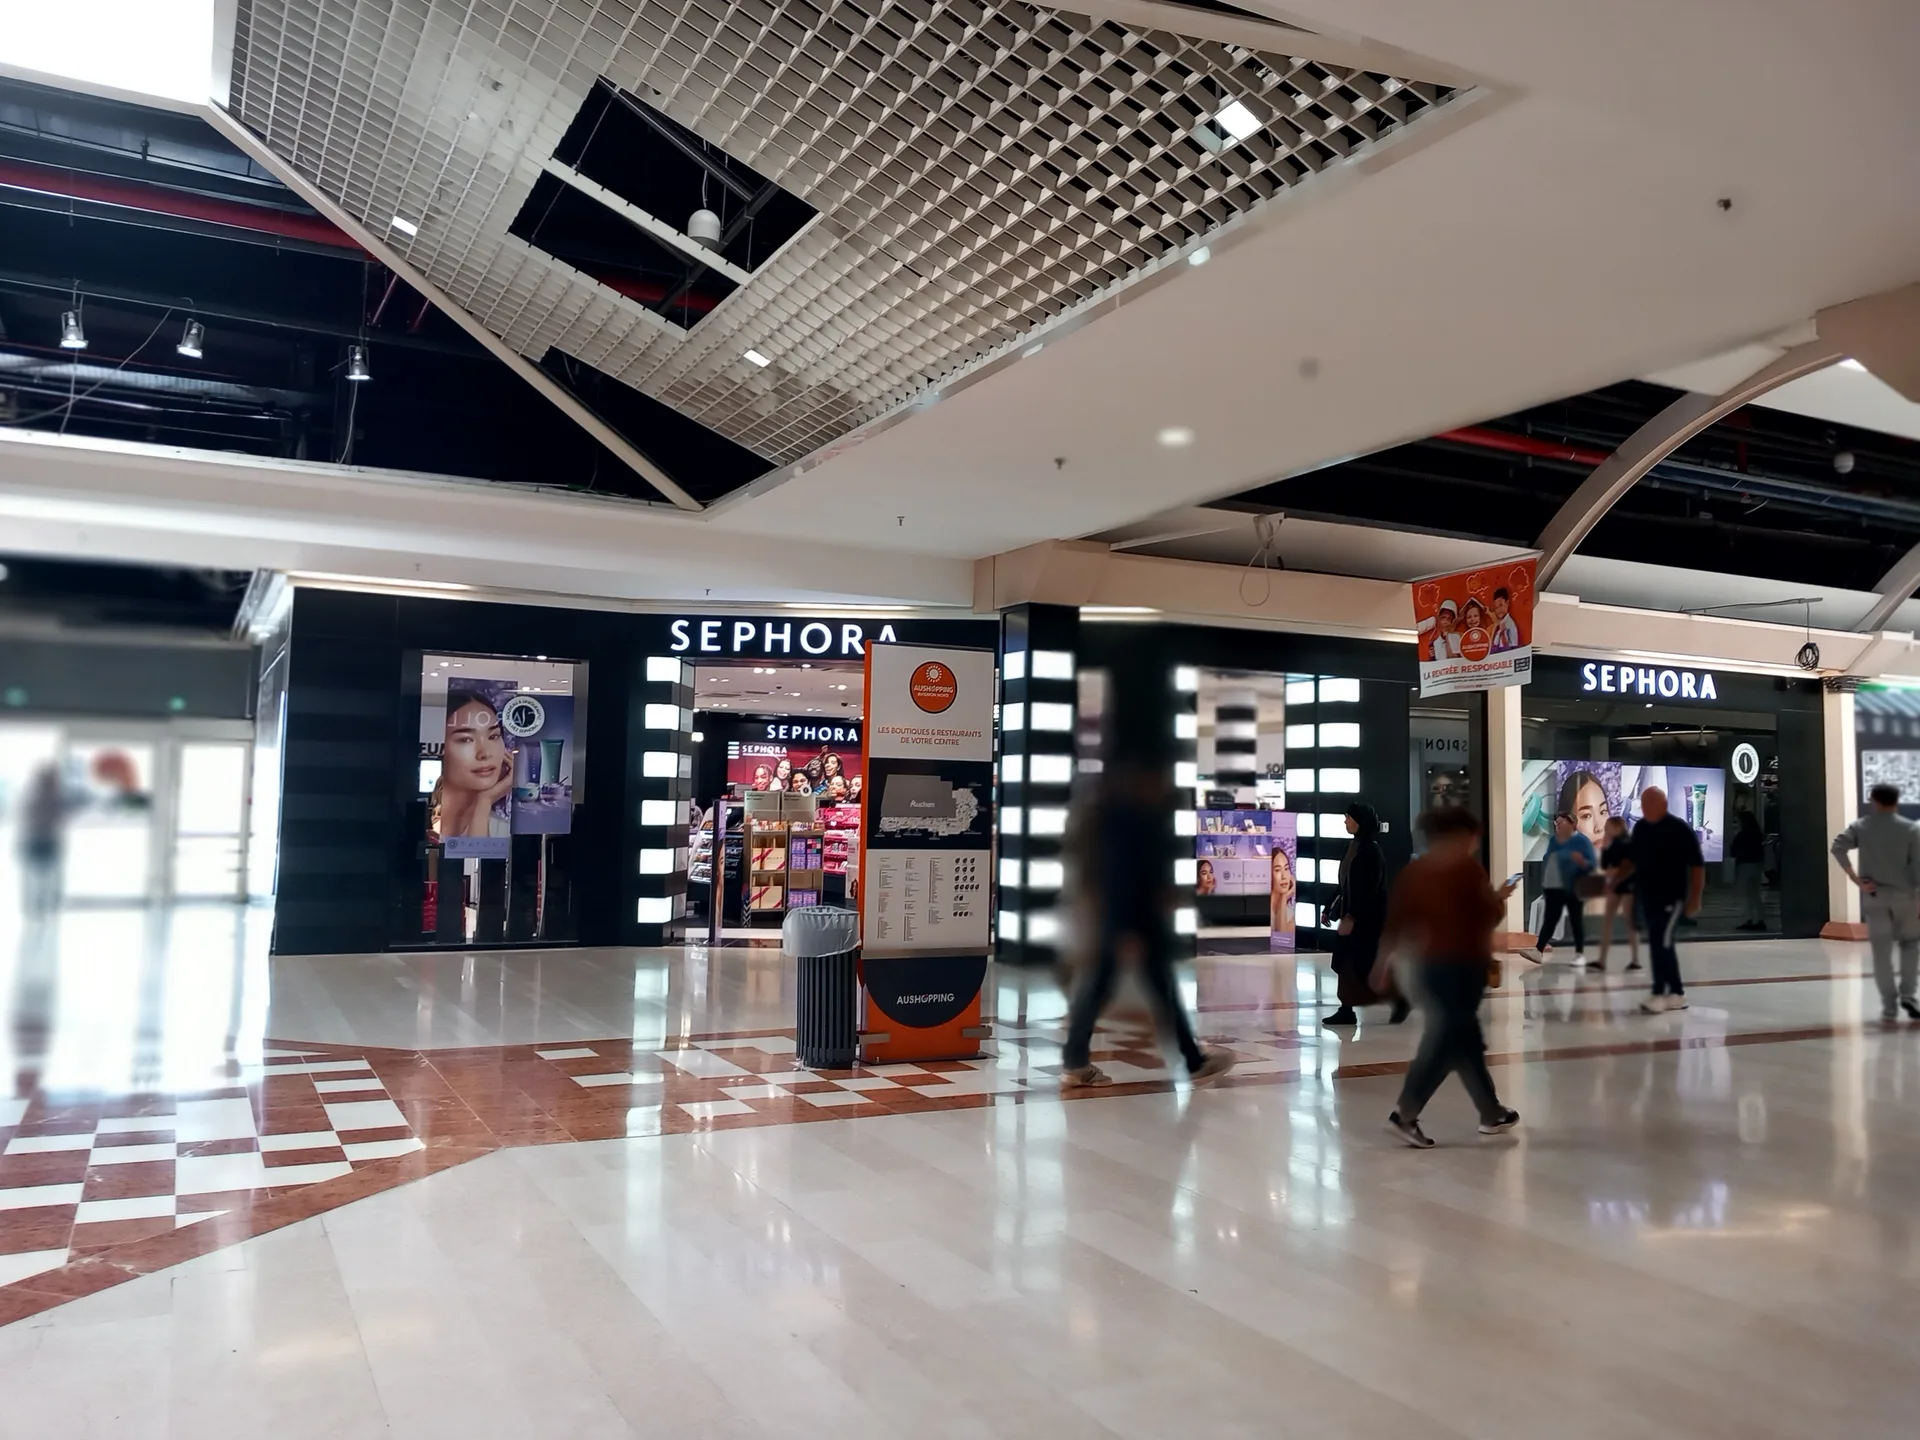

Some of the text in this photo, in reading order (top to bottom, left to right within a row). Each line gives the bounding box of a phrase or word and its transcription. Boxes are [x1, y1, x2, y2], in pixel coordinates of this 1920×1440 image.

[1423, 671, 1432, 681] LA
[1432, 665, 1459, 678] RENTRÉE
[1461, 659, 1513, 674] RESPONSABLE
[1583, 662, 1718, 700] SEPHORA
[913, 684, 954, 694] AUSHOPPING
[766, 724, 859, 742] SEPHORA
[877, 726, 982, 738] LES BOUTIQUES & RESTAURANTS
[900, 736, 960, 746] DE VOTRE CENTRE
[742, 744, 787, 754] SEPHORA
[910, 800, 935, 808] Auchan
[896, 993, 955, 1005] AUSHOPPING
